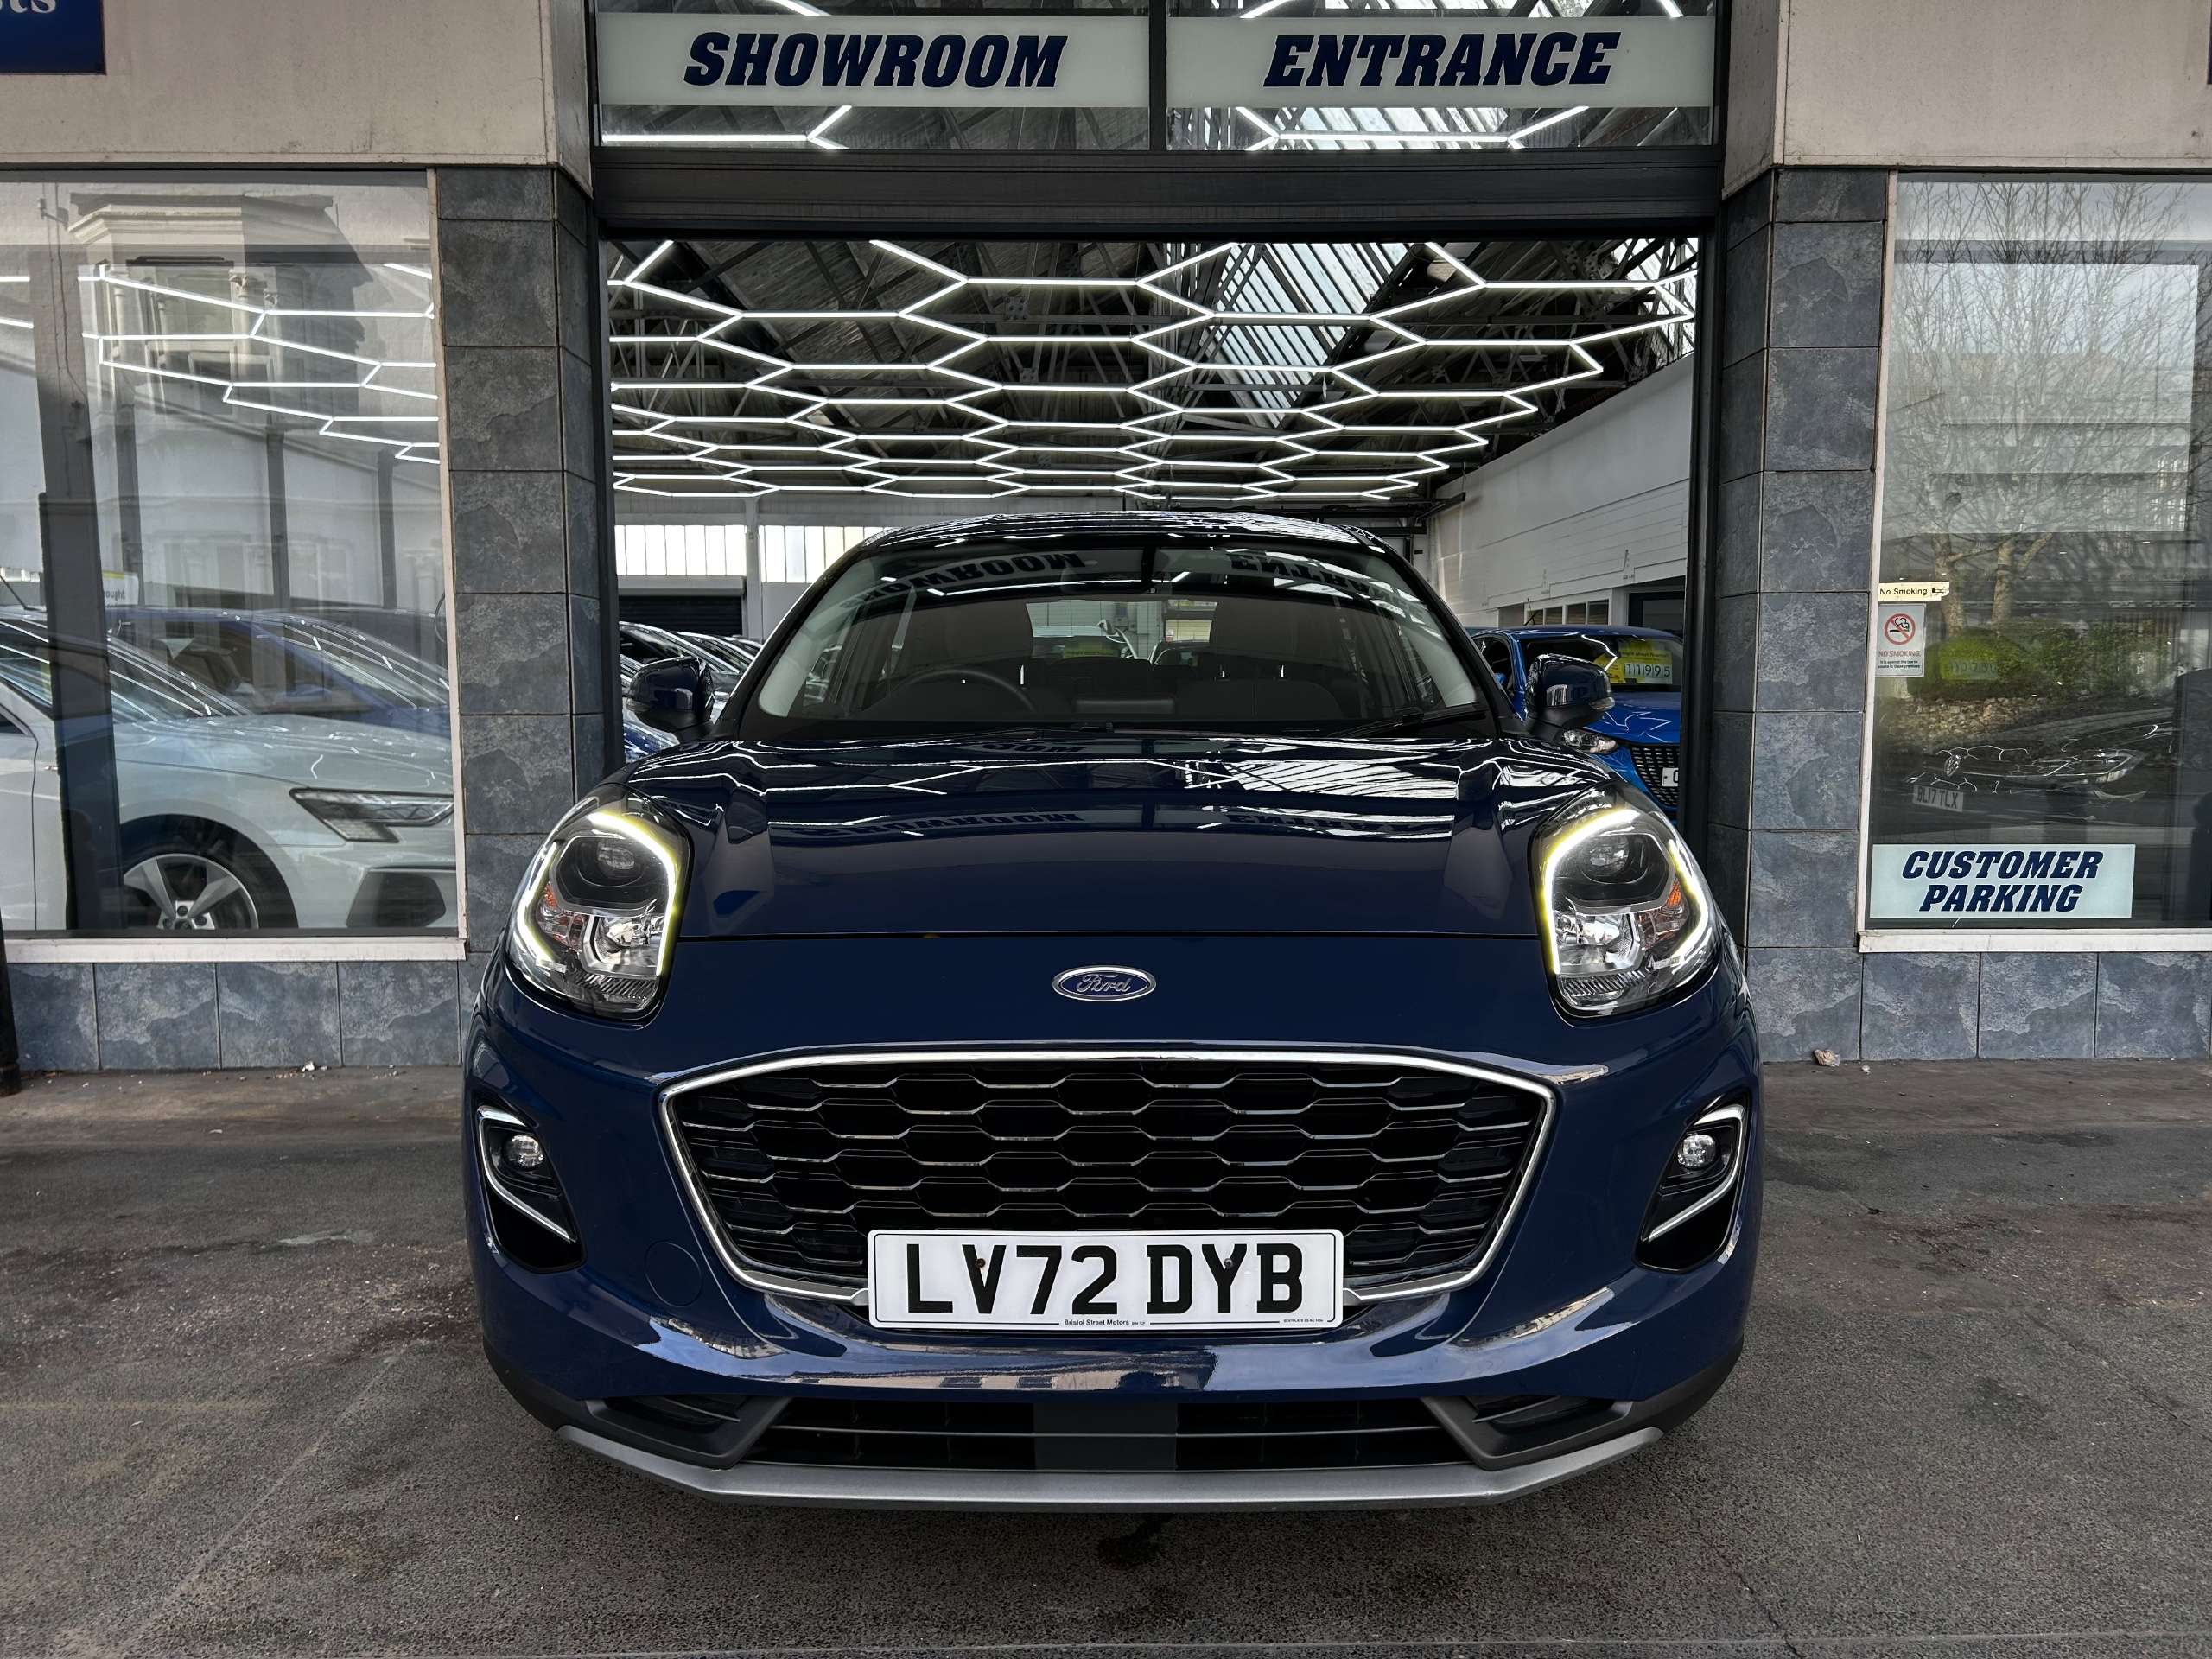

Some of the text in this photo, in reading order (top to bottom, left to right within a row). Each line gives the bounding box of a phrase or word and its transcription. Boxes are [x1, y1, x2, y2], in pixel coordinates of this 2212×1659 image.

[683, 32, 1068, 88] SHOWROOM
[1263, 31, 1621, 87] ENTRANCE
[1893, 588, 1928, 596] Smoking
[1626, 664, 1671, 678] 11995
[1917, 786, 1959, 809] BL17 TLX
[1902, 851, 2104, 879] CUSTOMER
[1919, 884, 2083, 912] PARKING
[1076, 973, 1132, 993] Ford
[906, 1243, 1303, 1315] LV72 DYB
